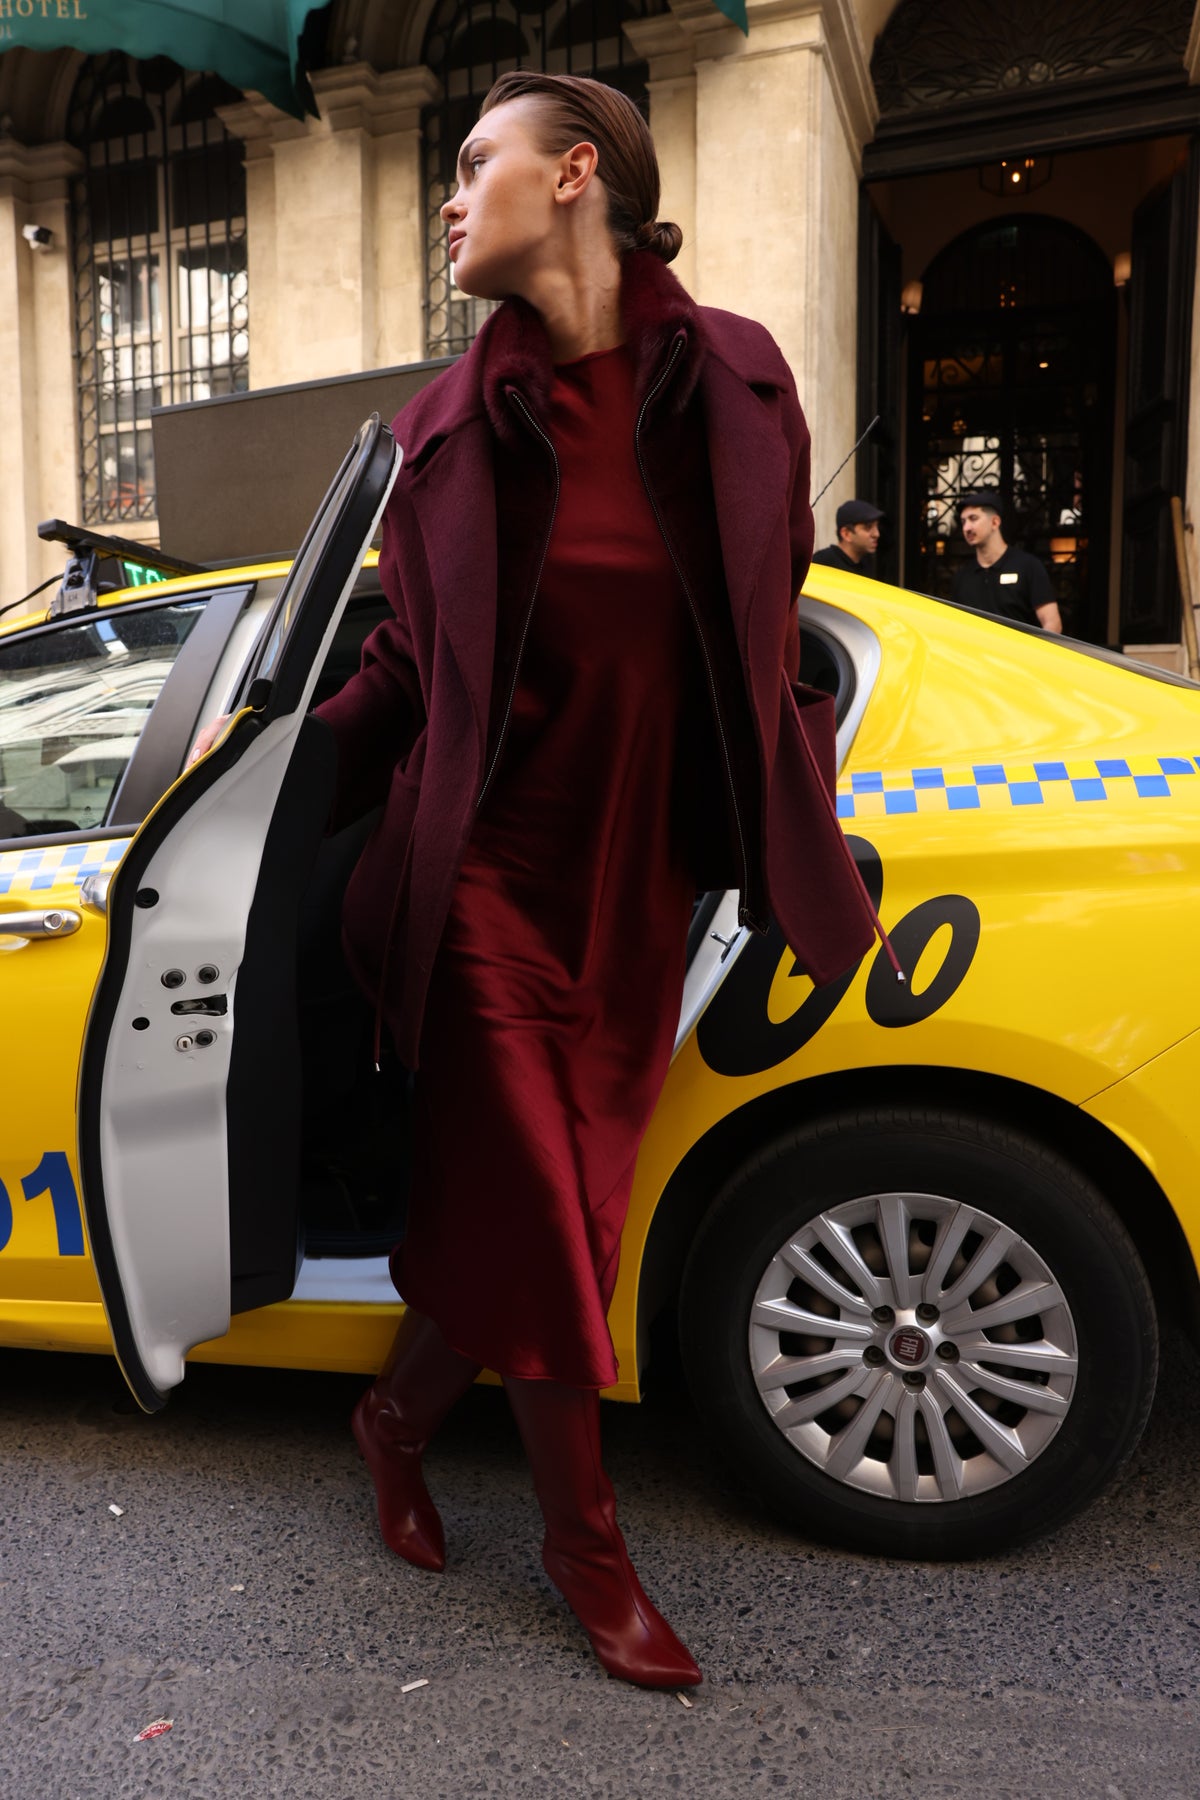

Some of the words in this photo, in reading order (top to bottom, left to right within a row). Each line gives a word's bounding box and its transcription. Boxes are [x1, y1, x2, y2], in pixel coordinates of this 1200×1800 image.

[0, 0, 88, 19] HOTEL
[0, 1151, 85, 1256] 1
[899, 1336, 919, 1360] FIAT
